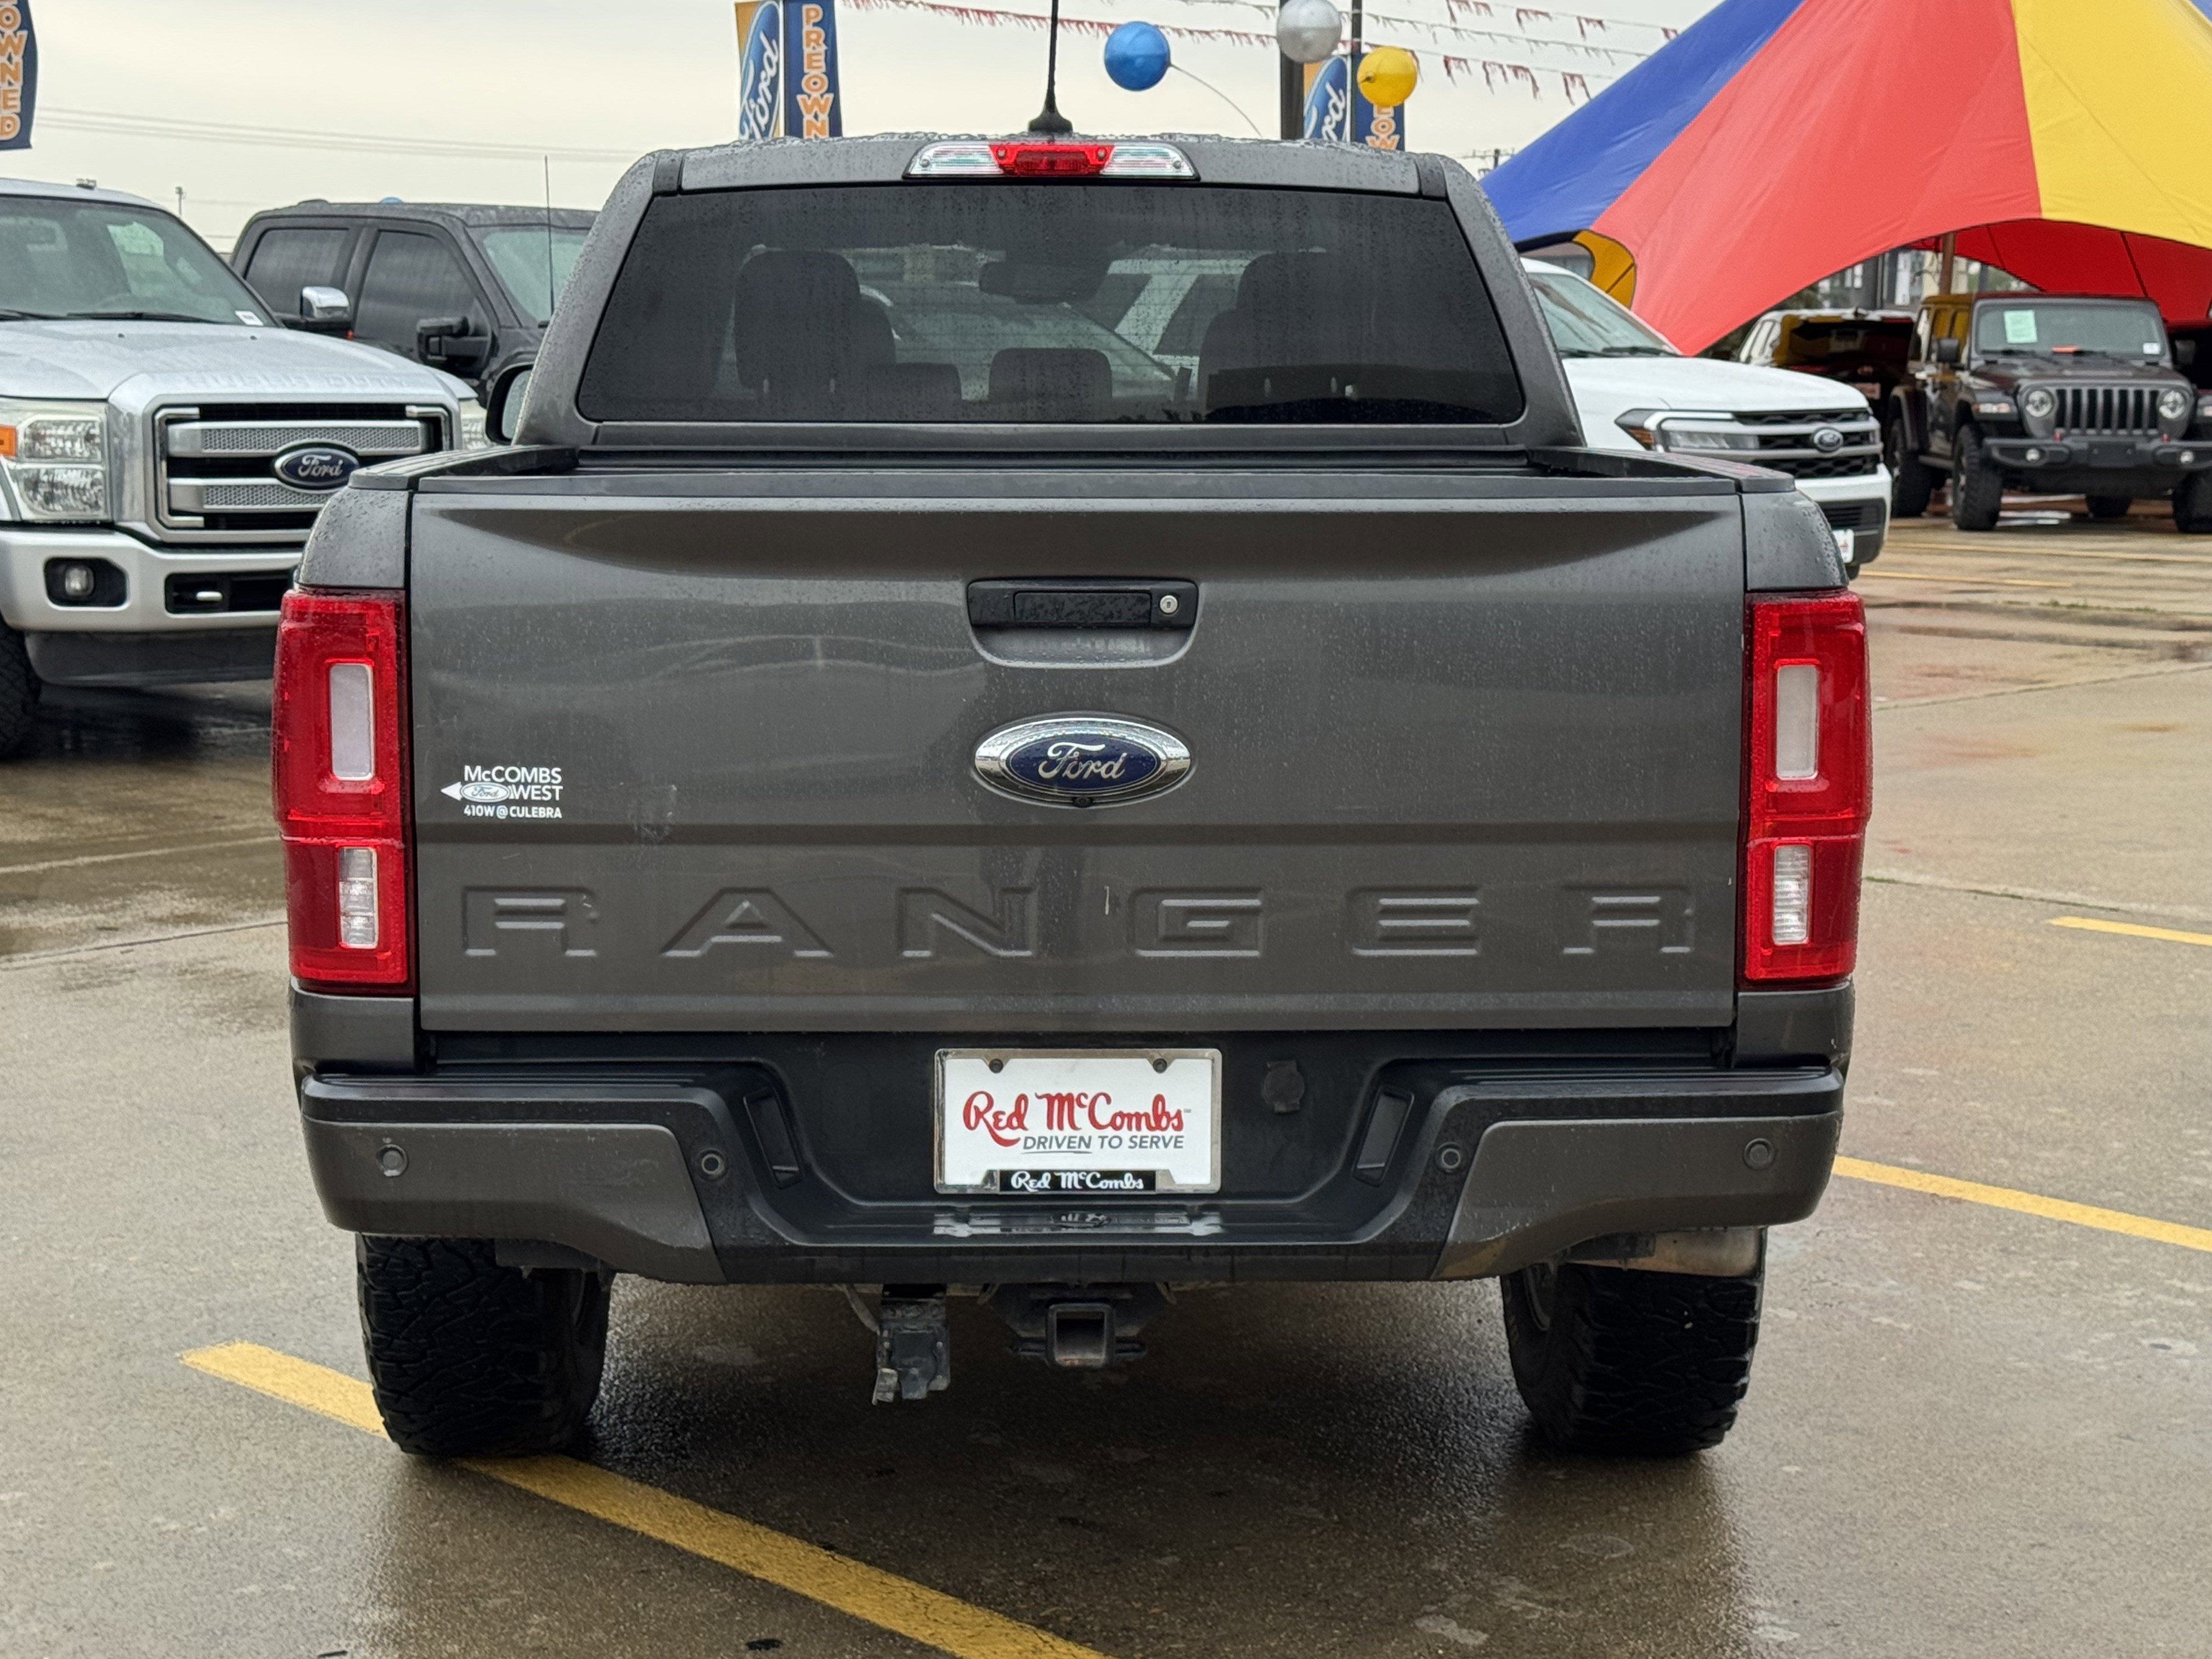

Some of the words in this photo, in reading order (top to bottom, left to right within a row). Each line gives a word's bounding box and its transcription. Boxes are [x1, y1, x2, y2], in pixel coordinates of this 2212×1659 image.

[0, 0, 28, 141] OWNED
[298, 455, 343, 477] Ford
[1038, 742, 1128, 780] Ford
[464, 765, 562, 784] McCOMBS
[471, 787, 500, 798] Ford
[511, 785, 563, 801] WEST
[509, 806, 562, 819] CULEBRA
[460, 885, 1694, 957] RANGER
[963, 1091, 1029, 1147] Red
[1035, 1092, 1184, 1132] McCombs
[1023, 1135, 1092, 1149] DRIVEN
[1099, 1135, 1122, 1149] TO
[1128, 1135, 1184, 1149] SERVE
[1011, 1170, 1052, 1193] Red
[1054, 1171, 1144, 1190] McCombs
